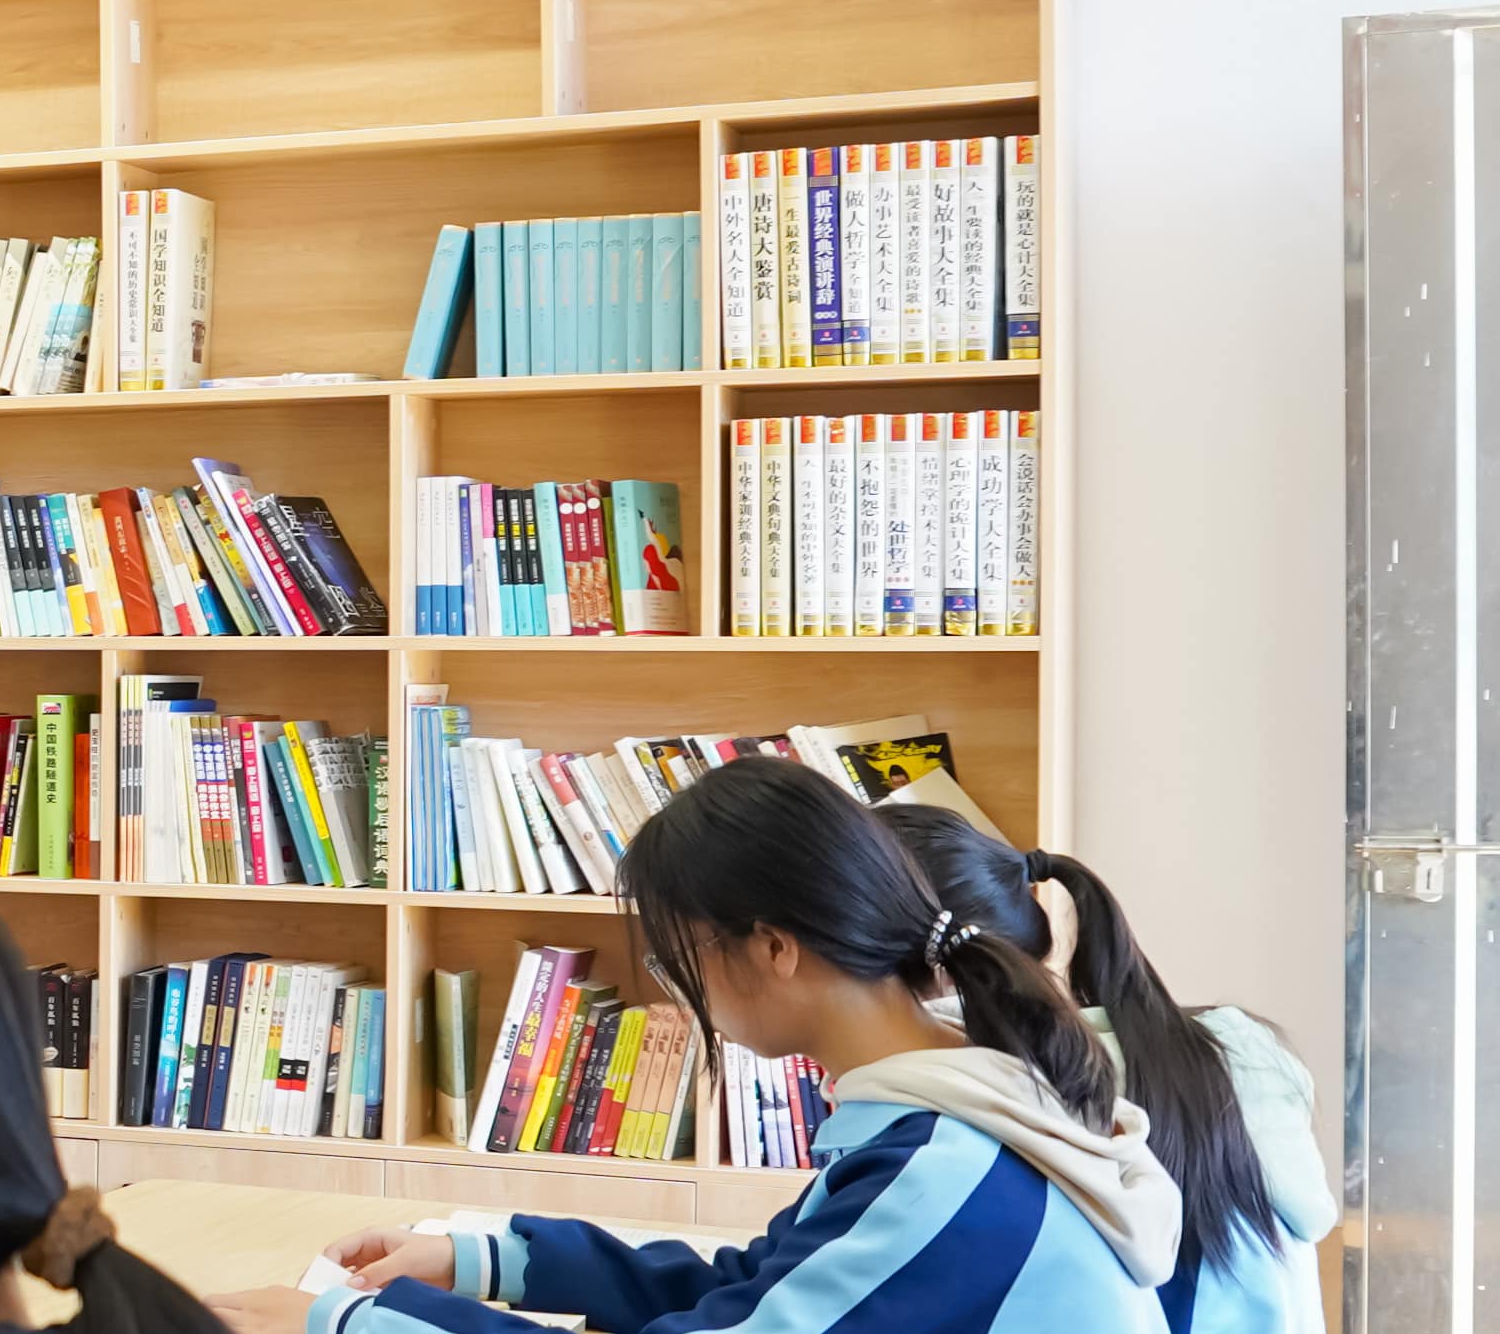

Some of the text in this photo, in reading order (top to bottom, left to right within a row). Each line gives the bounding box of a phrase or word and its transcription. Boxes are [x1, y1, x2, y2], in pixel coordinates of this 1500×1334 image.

[151, 228, 167, 334] 国学知识全知道
[724, 194, 745, 318] 中外名人全知道
[752, 192, 774, 301] 唐诗大鉴赏
[784, 194, 802, 305] 一生最爱古诗词
[813, 189, 836, 306] 世界经典演讲辞
[874, 186, 894, 313] 办事艺术大全集
[933, 182, 955, 308] 好故事大全集
[1015, 179, 1036, 307] 玩的就是心计大全集
[859, 458, 880, 580] 不抱怨的世界
[980, 454, 1003, 583] 成功学大全集
[1014, 452, 1036, 578] 会说话会办事会做人
